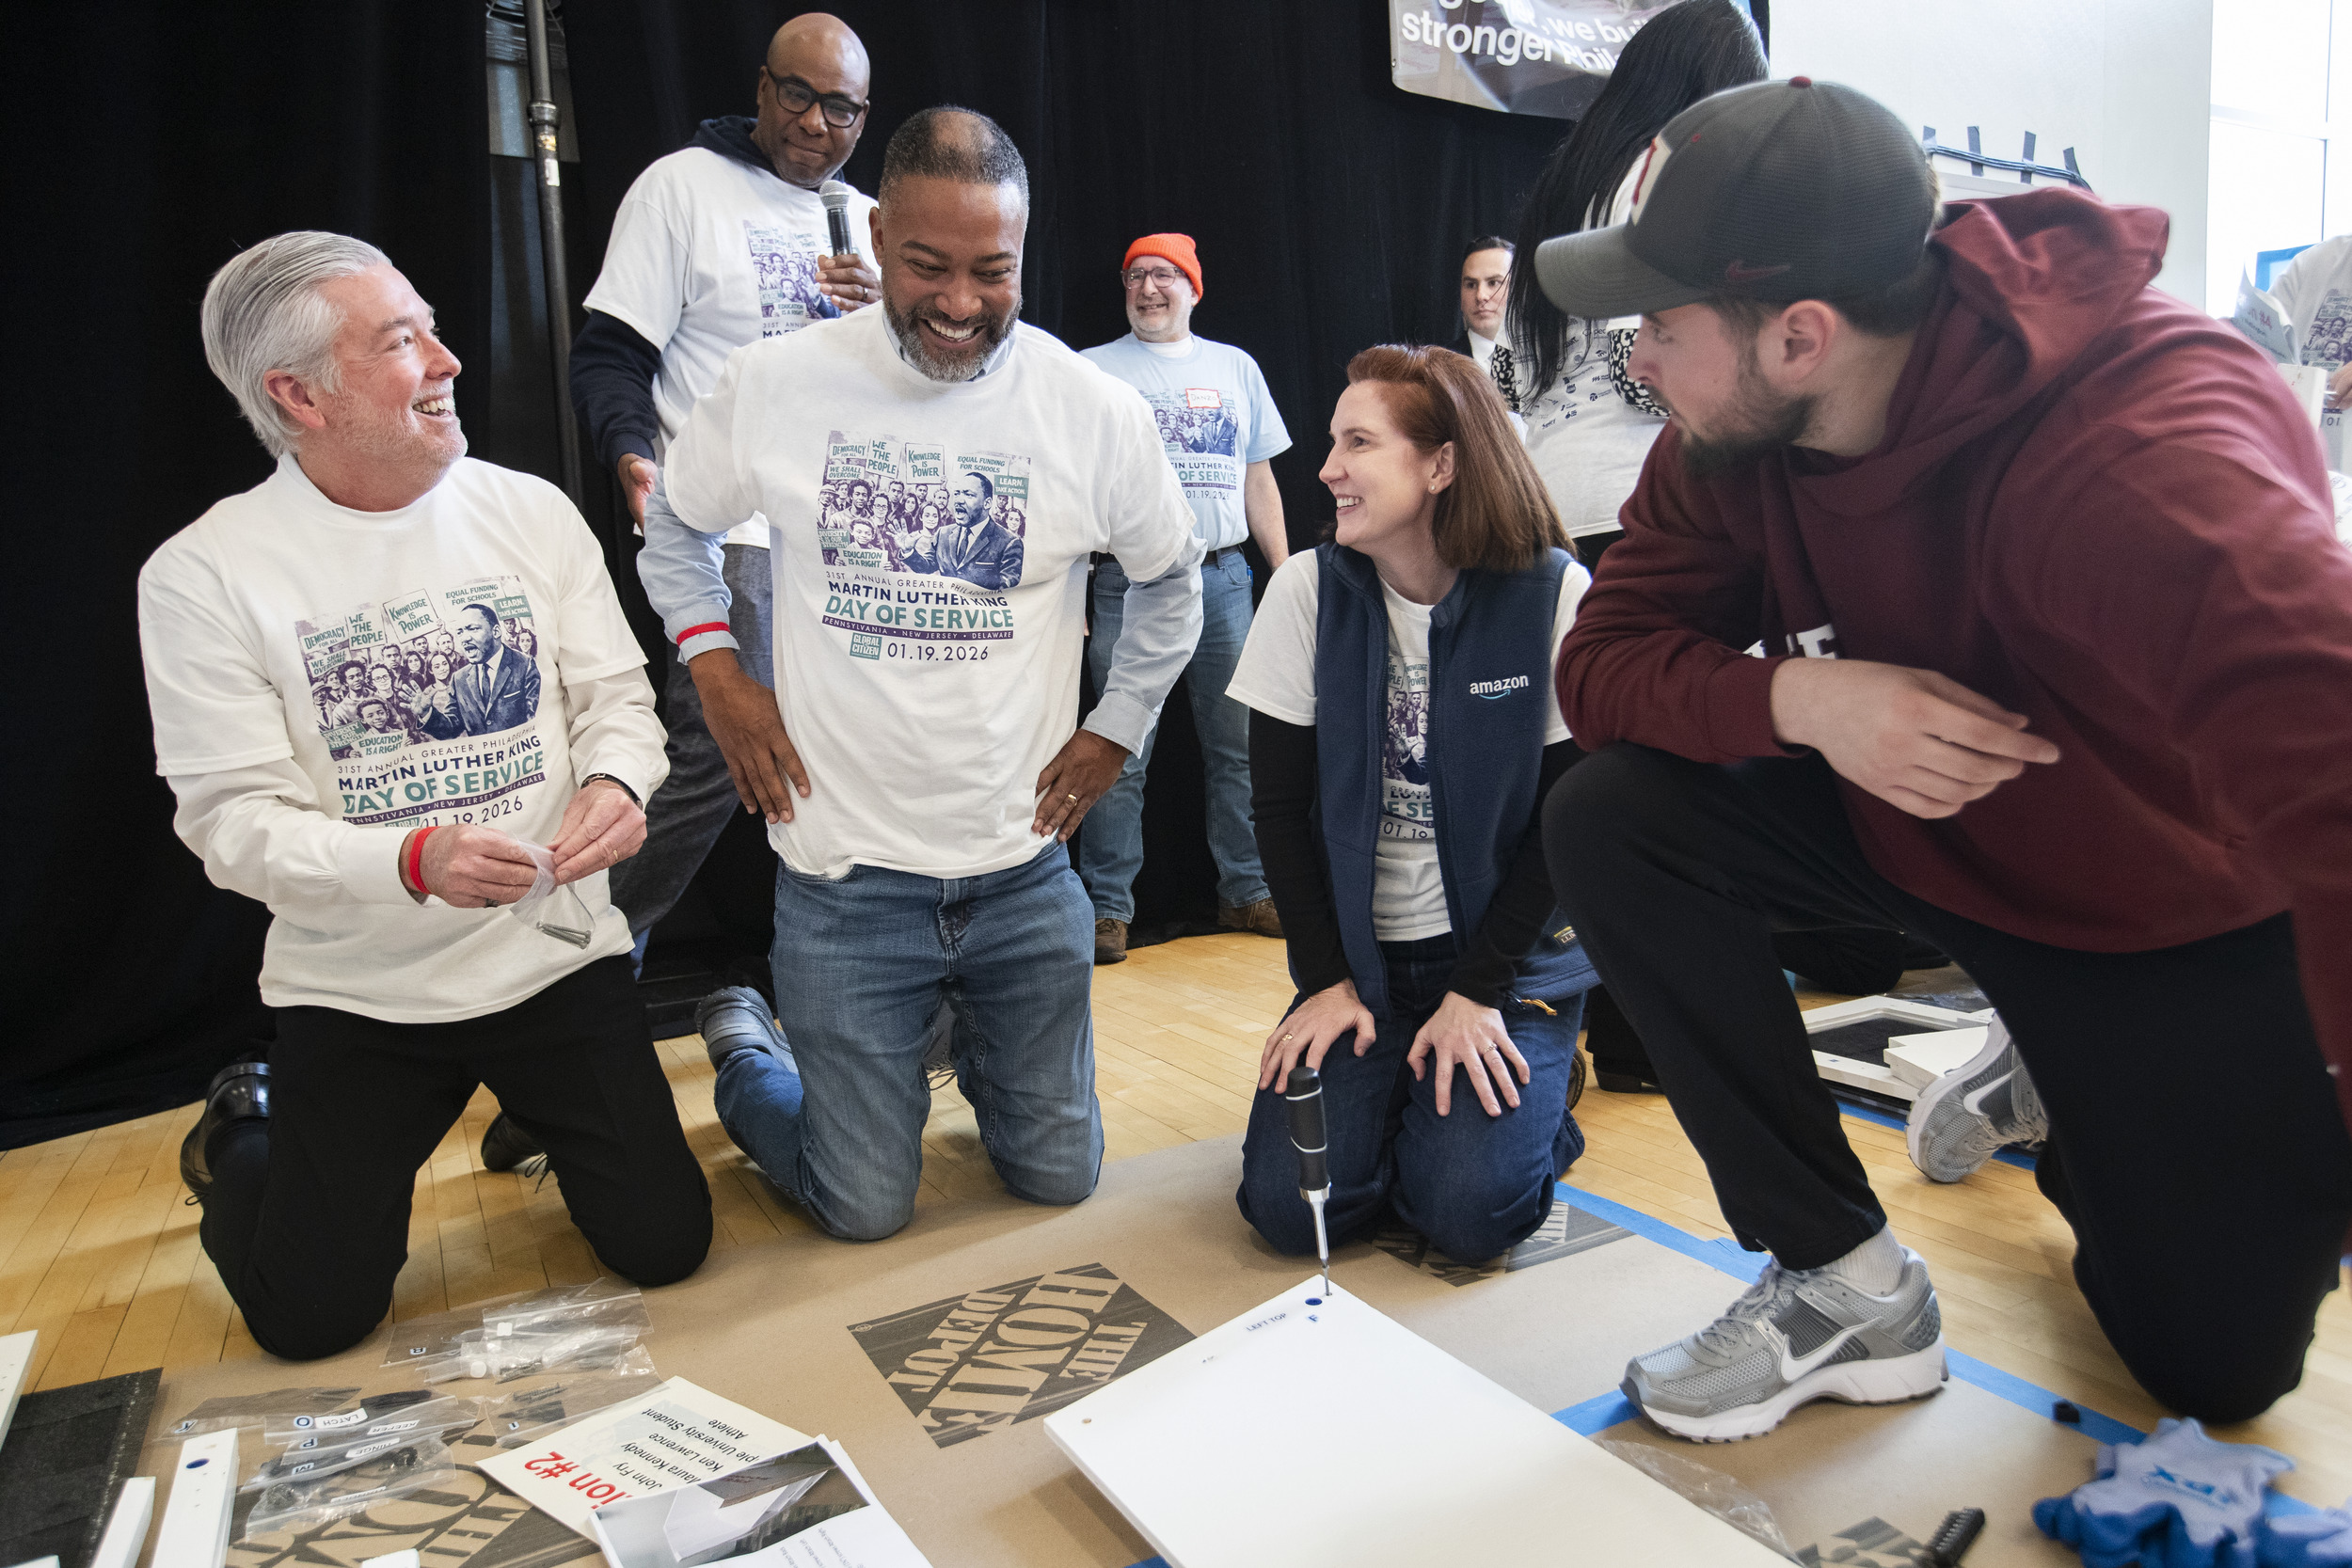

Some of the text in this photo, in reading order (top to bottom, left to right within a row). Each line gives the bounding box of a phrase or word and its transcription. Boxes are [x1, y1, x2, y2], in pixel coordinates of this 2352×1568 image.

[1402, 9, 1551, 66] stronger
[1547, 17, 1596, 41] we
[833, 445, 866, 455] DEMOCRACY
[873, 440, 886, 450] WE
[873, 450, 891, 462] THE
[979, 457, 1006, 467] FUNDING
[867, 459, 898, 475] PEOPLE
[911, 465, 939, 478] POWER
[974, 465, 1000, 473] SCHOOLS
[1179, 471, 1236, 483] OF SERVICE
[843, 550, 882, 560] EDUCATION
[826, 571, 845, 579] 31ST
[854, 574, 891, 586] ANNUAL
[898, 579, 945, 589] GREATER
[446, 583, 499, 598] EQUAL FUNDING
[452, 592, 497, 606] FOR SCHOOLS
[828, 581, 891, 601] MARTIN
[898, 592, 969, 605] LUTHER
[348, 613, 364, 625] WE
[409, 611, 417, 620] IS
[825, 595, 1013, 628] DAY OF SERVICE
[353, 621, 373, 634] THE
[399, 613, 434, 635] POWER
[824, 617, 887, 634] PENNSYLVANIA
[304, 626, 346, 650] DEMOCRACY
[350, 630, 384, 647] PEOPLE
[853, 634, 881, 646] GLOBAL
[311, 650, 347, 669] WE SHALL
[887, 642, 988, 660] 01.19.2026
[313, 657, 347, 675] OVERCOME
[1470, 675, 1529, 694] amazon
[358, 734, 404, 748] EDUCATION
[368, 753, 415, 773] ANNUAL
[421, 744, 474, 758] GREATER
[483, 725, 535, 749] PHILADELPHIA
[379, 741, 402, 753] RIGHT
[339, 736, 541, 790] MARTIN LUTHER KING
[342, 751, 543, 814] DAY OF SERVICE
[1391, 786, 1429, 796] GREATE
[344, 773, 543, 824] PENNSYLVANIA NEW JERSEY DELAWARE
[1247, 1312, 1286, 1331] LEFT TOP
[916, 1272, 1125, 1433] HOME
[296, 1414, 358, 1426] O LATCH
[708, 1419, 749, 1439] Athlete
[303, 1421, 416, 1448] P KEEPER
[642, 1409, 759, 1463] ple University Student
[621, 1442, 670, 1469] Kennedy
[649, 1433, 723, 1472] Ken Lawrence
[524, 1451, 633, 1510] ion #2
[612, 1462, 662, 1489] John Fry
